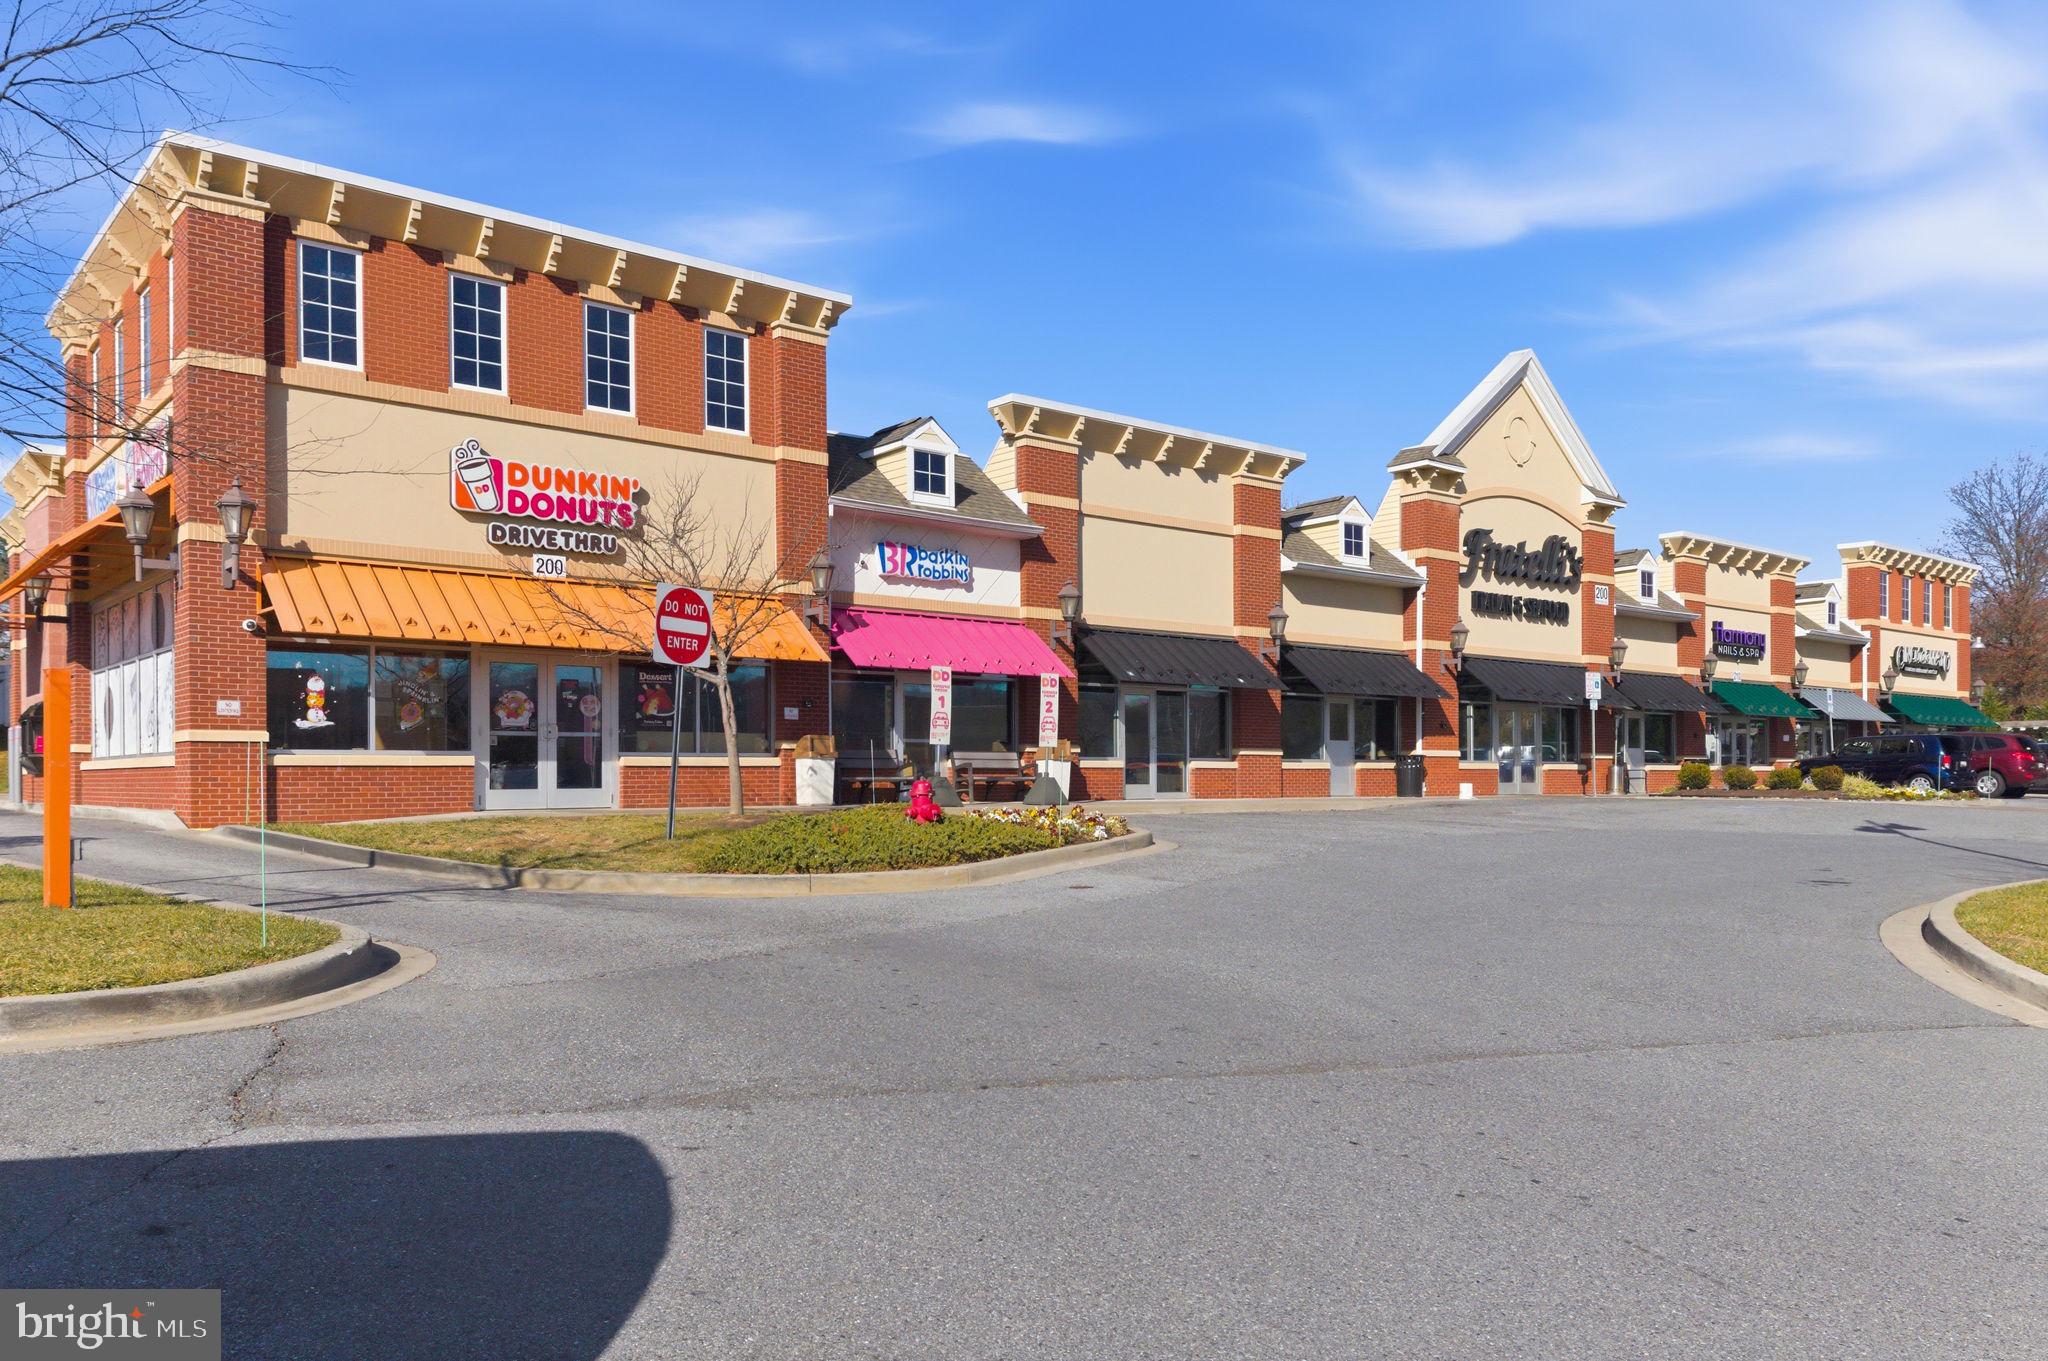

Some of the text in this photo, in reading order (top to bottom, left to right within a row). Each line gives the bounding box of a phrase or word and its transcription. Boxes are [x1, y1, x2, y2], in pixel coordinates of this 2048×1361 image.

[507, 461, 639, 501] DUNKIN'
[507, 489, 634, 528] DONUTS
[491, 523, 617, 553] DRIVE THRU
[536, 557, 564, 576] 200
[878, 541, 918, 576] BR
[1595, 587, 1609, 601] 200
[665, 600, 705, 617] DO NOT
[667, 635, 699, 651] ENTER
[1718, 645, 1760, 658] NAILS & SPA
[938, 695, 946, 709] 1
[1045, 700, 1054, 713] 2
